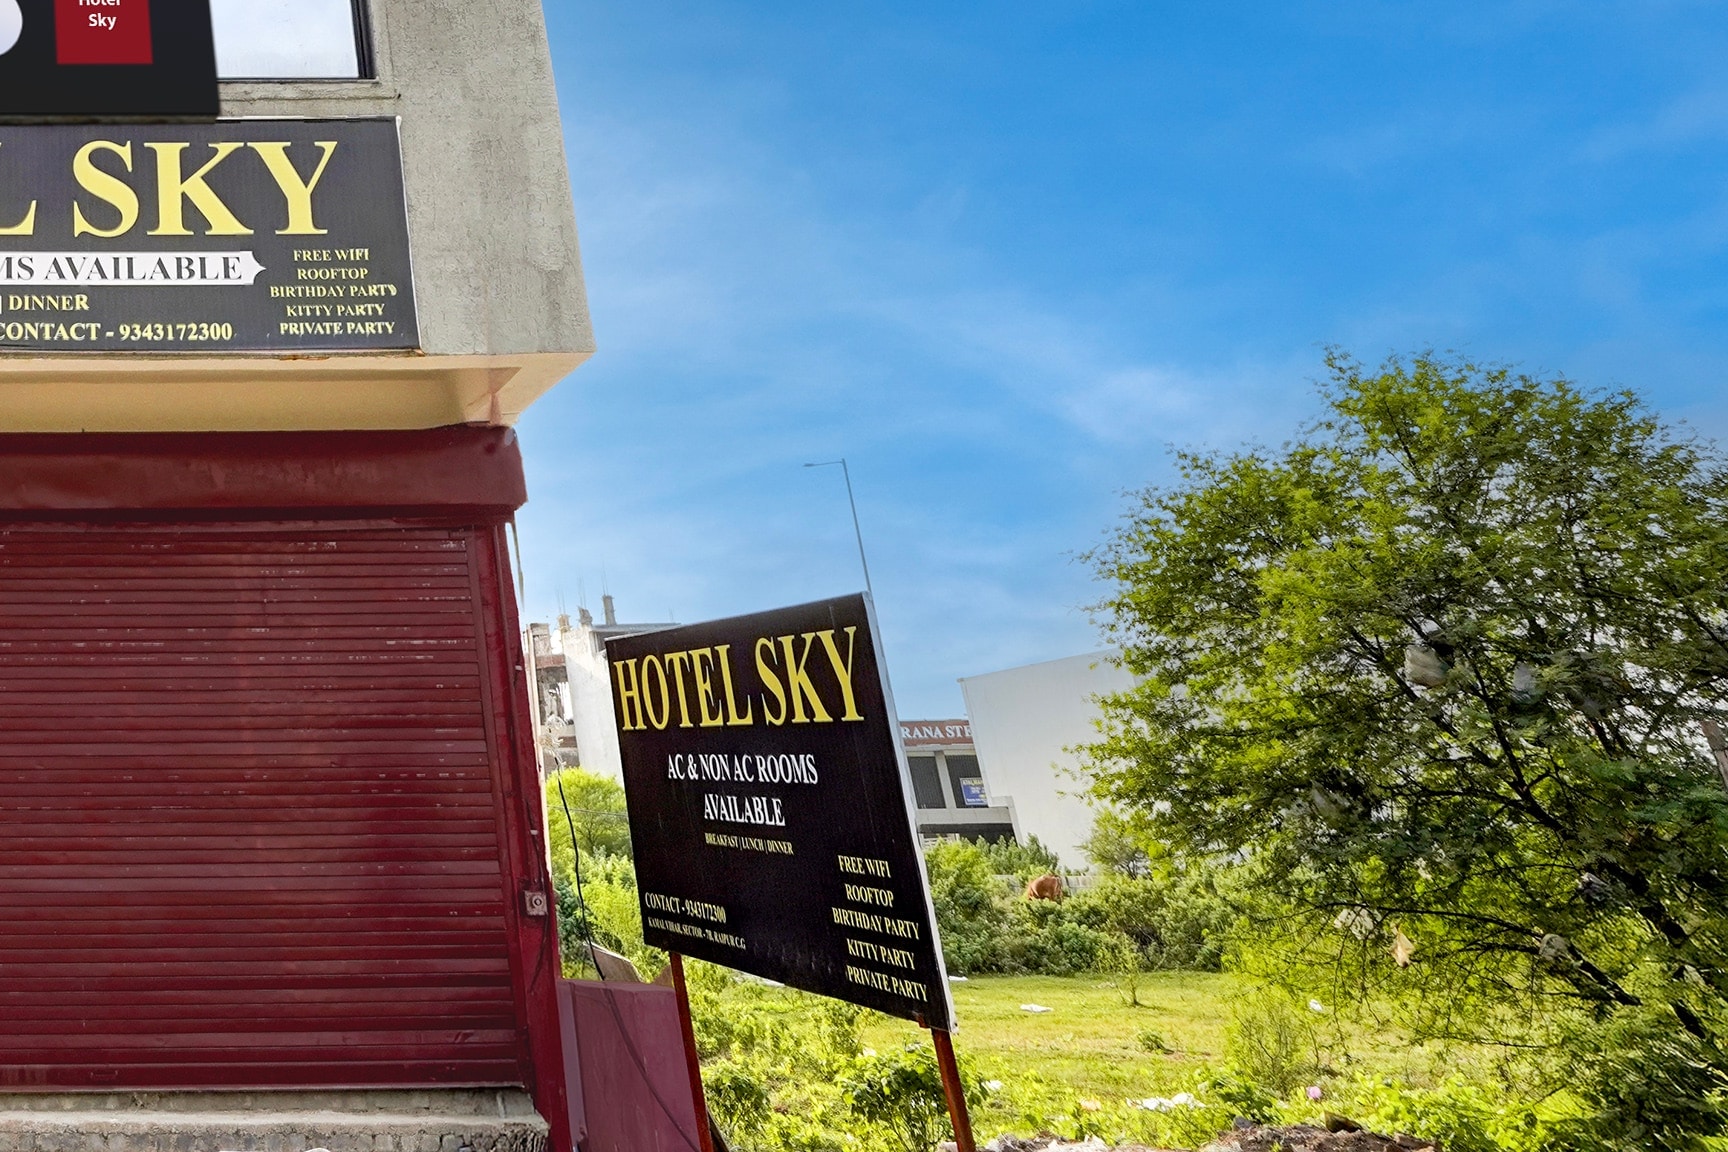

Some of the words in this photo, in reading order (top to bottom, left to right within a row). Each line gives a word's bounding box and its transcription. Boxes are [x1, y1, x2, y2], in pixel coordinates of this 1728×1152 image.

[88, 13, 117, 31] Sky
[73, 140, 338, 238] SKY
[293, 250, 332, 261] FREE
[334, 248, 369, 261] WIFI
[45, 256, 243, 281] AVAILABLE
[297, 268, 369, 280] ROOFTOP
[270, 286, 346, 298] BIRTHDAY
[349, 284, 397, 296] PARTY
[8, 294, 90, 311] DINNER
[286, 305, 333, 317] KITTY
[336, 303, 385, 316] PARTY
[119, 322, 233, 341] 9343172300
[279, 322, 344, 335] PRIVATE
[346, 321, 396, 335] PARTY
[613, 644, 752, 731] HOTEL
[755, 625, 864, 727] SKY
[900, 726, 945, 738] RANA
[668, 753, 686, 780] AC
[687, 753, 699, 780] &
[698, 753, 731, 781] NON
[734, 754, 754, 782] AC
[755, 753, 819, 784] ROOMS
[704, 793, 786, 826] AVAILABLE
[837, 855, 865, 875] FREE
[864, 858, 891, 878] WIFI
[645, 892, 680, 914] CONTACT
[844, 883, 894, 908] ROOFTOP
[832, 907, 883, 933] BIRTHDAY
[884, 916, 920, 940] PARTY
[846, 938, 879, 962] KITTY
[879, 945, 916, 970] PARTY
[846, 964, 891, 992] PRIVATE
[891, 976, 928, 1002] PARTY
